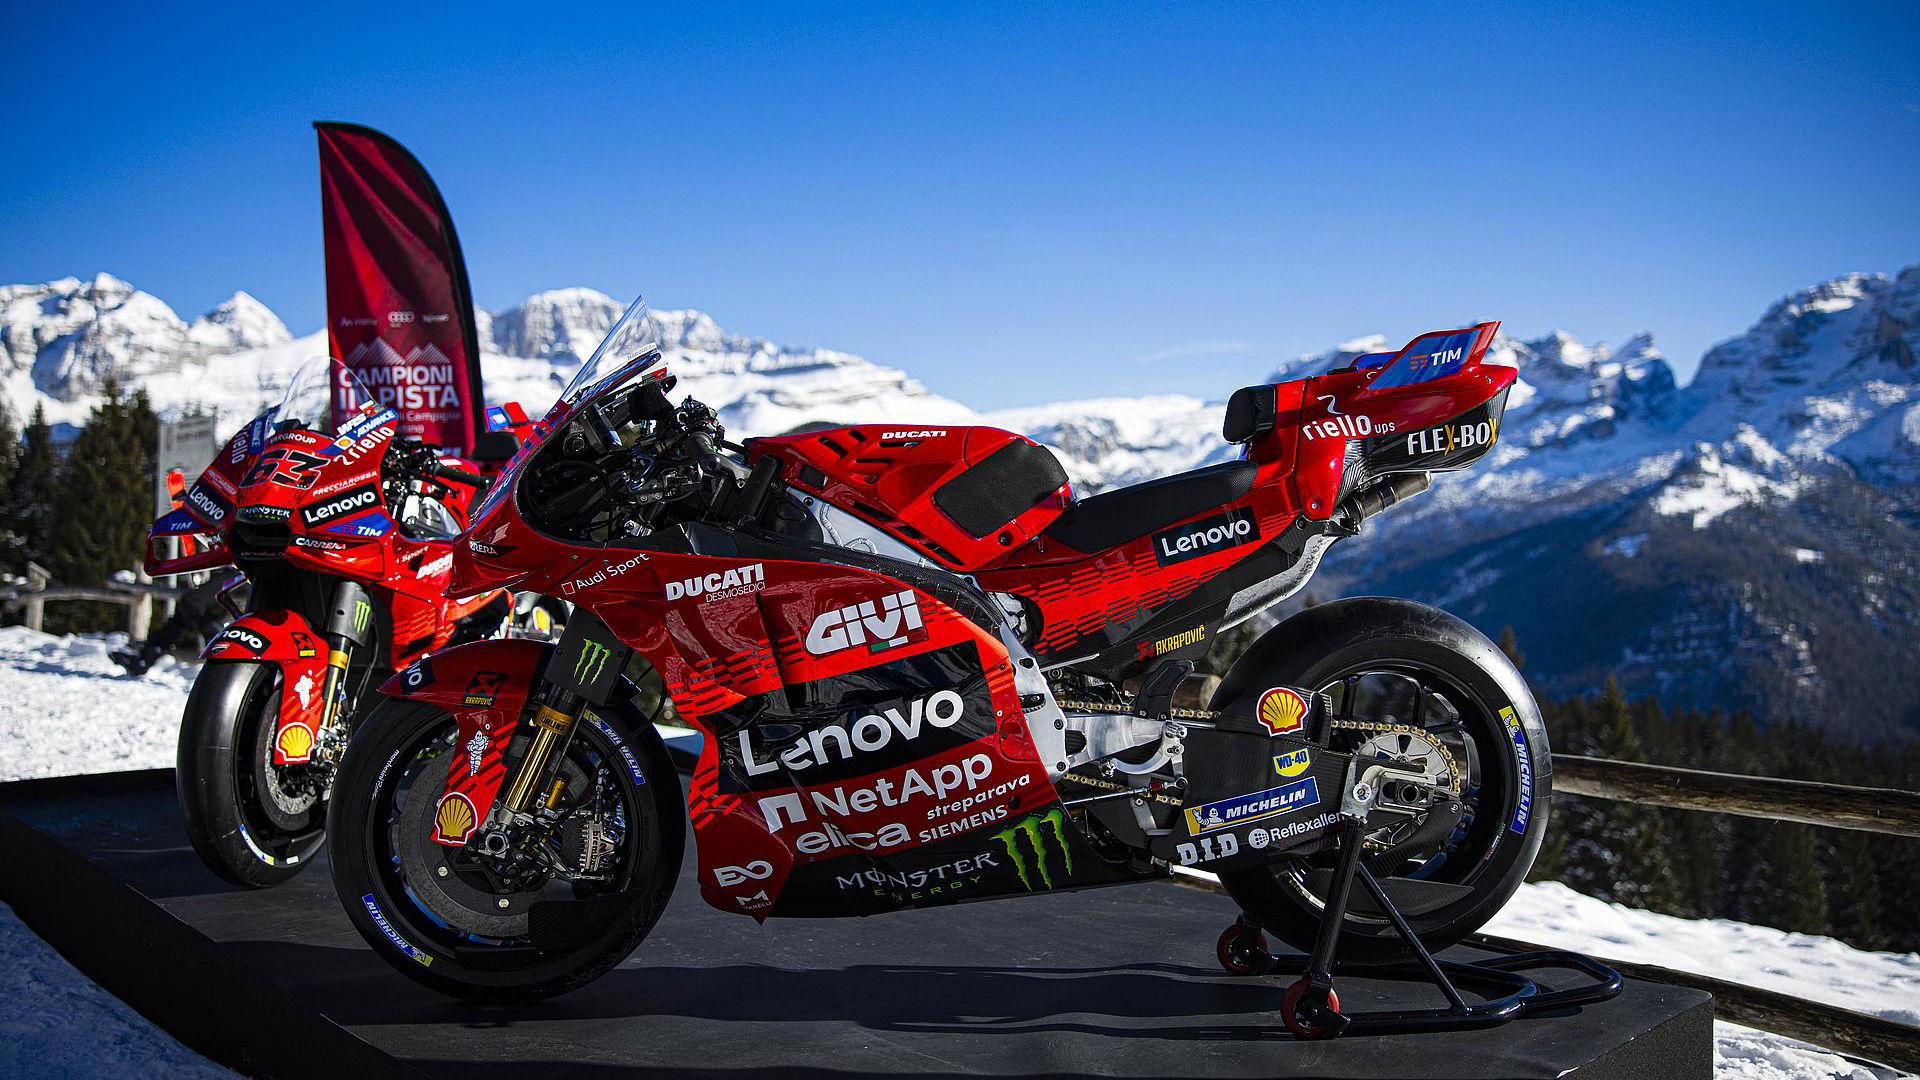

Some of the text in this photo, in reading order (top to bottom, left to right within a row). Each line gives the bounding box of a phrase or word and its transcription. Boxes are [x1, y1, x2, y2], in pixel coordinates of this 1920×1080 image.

[1430, 347, 1462, 366] TIM
[338, 365, 454, 388] CAMPIONI
[378, 385, 460, 409] PISTA
[348, 426, 395, 459] riello
[881, 430, 947, 440] DUCATI
[1302, 414, 1396, 441] riello ups
[1407, 418, 1498, 456] FLEX-BOX
[239, 448, 331, 490] 63
[313, 471, 378, 497] FRECCIAROSSA
[189, 485, 225, 520] Lenovo
[304, 491, 376, 523] Lenovo
[171, 521, 193, 531] TIM
[357, 526, 383, 537] TIM
[1161, 519, 1252, 557] Lenovo
[295, 537, 346, 550] CARRERA
[576, 552, 650, 590] Audi Sport
[665, 563, 765, 601] DUCATI
[705, 582, 767, 603] DESMOSEDICI
[805, 589, 925, 655] GIVI
[738, 689, 964, 777] Lenovo
[1275, 750, 1308, 769] WD-40
[811, 752, 993, 818] NetApp
[926, 773, 1031, 821] streparava
[1514, 742, 1533, 825] MICHELIN
[1225, 788, 1306, 819] MICHELIN
[796, 821, 912, 854] elica
[918, 804, 1009, 843] SIEMENS
[592, 830, 601, 867] brembo
[874, 875, 981, 901] ENERGY
[366, 901, 409, 949] MICHELIN
